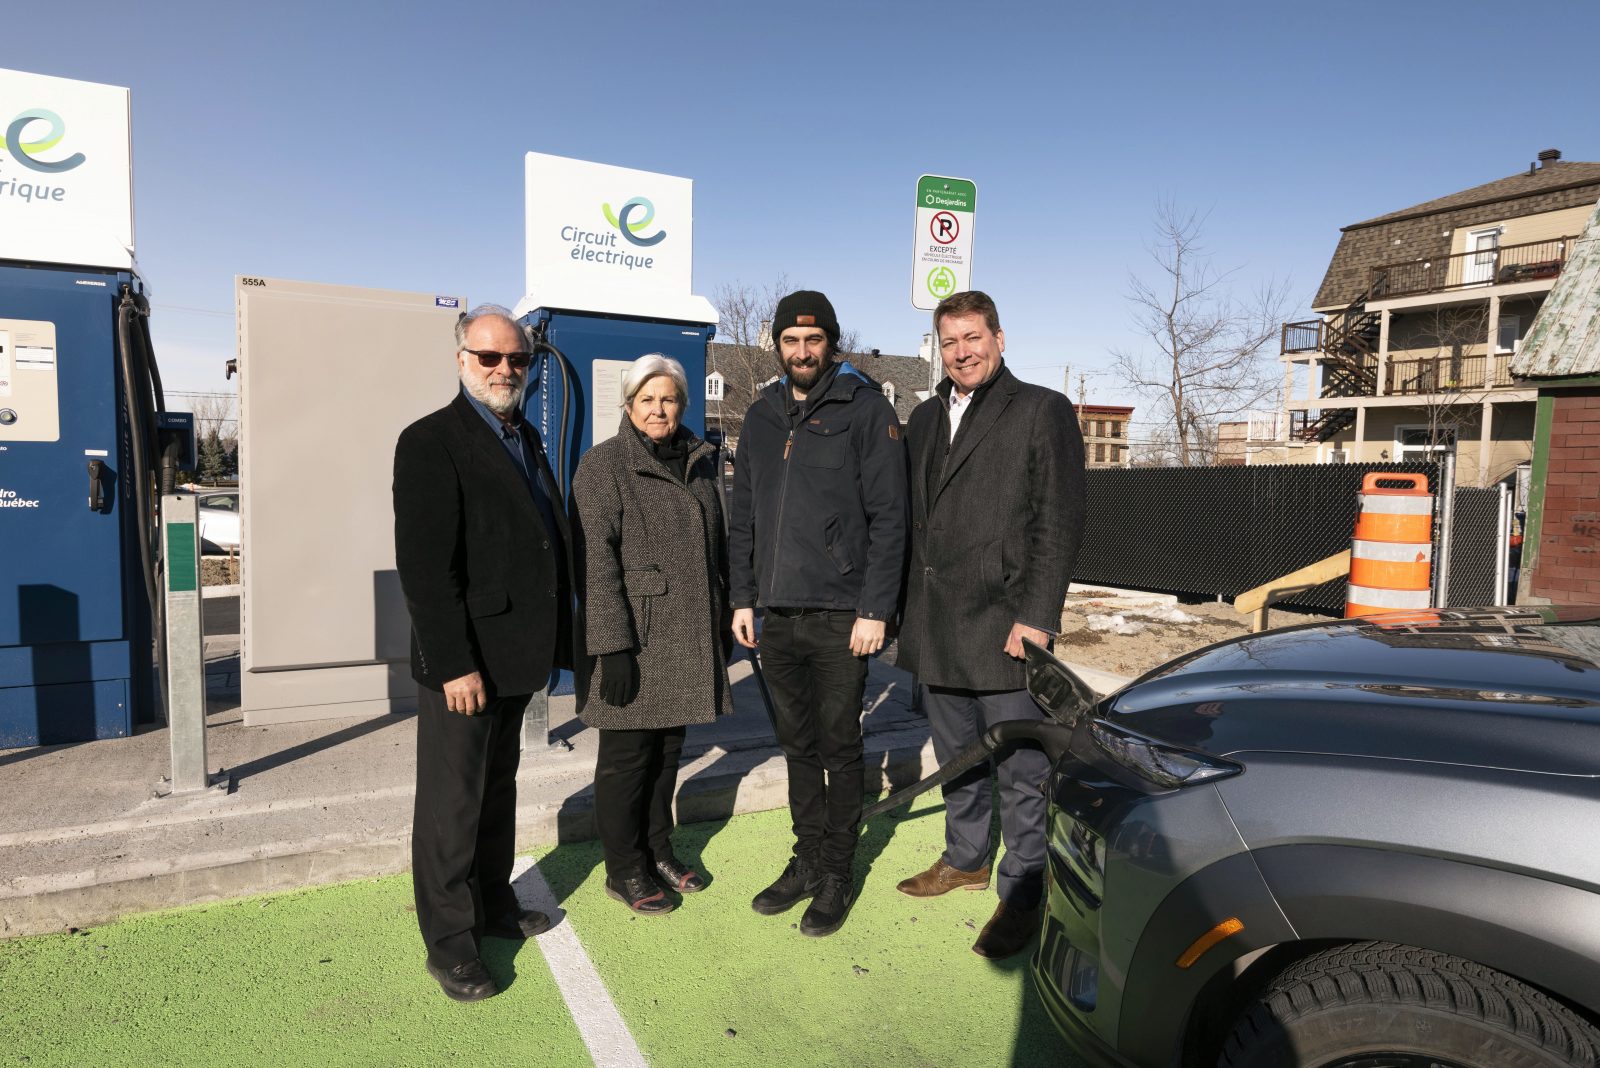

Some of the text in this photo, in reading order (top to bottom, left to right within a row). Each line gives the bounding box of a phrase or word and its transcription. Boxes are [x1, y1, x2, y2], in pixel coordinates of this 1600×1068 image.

[936, 197, 966, 206] Desjardins
[560, 225, 618, 247] Circuit
[570, 244, 654, 271] électrique
[930, 246, 957, 254] EXCEPTÉ
[242, 277, 266, 287] 555A
[541, 359, 549, 436] électriqu
